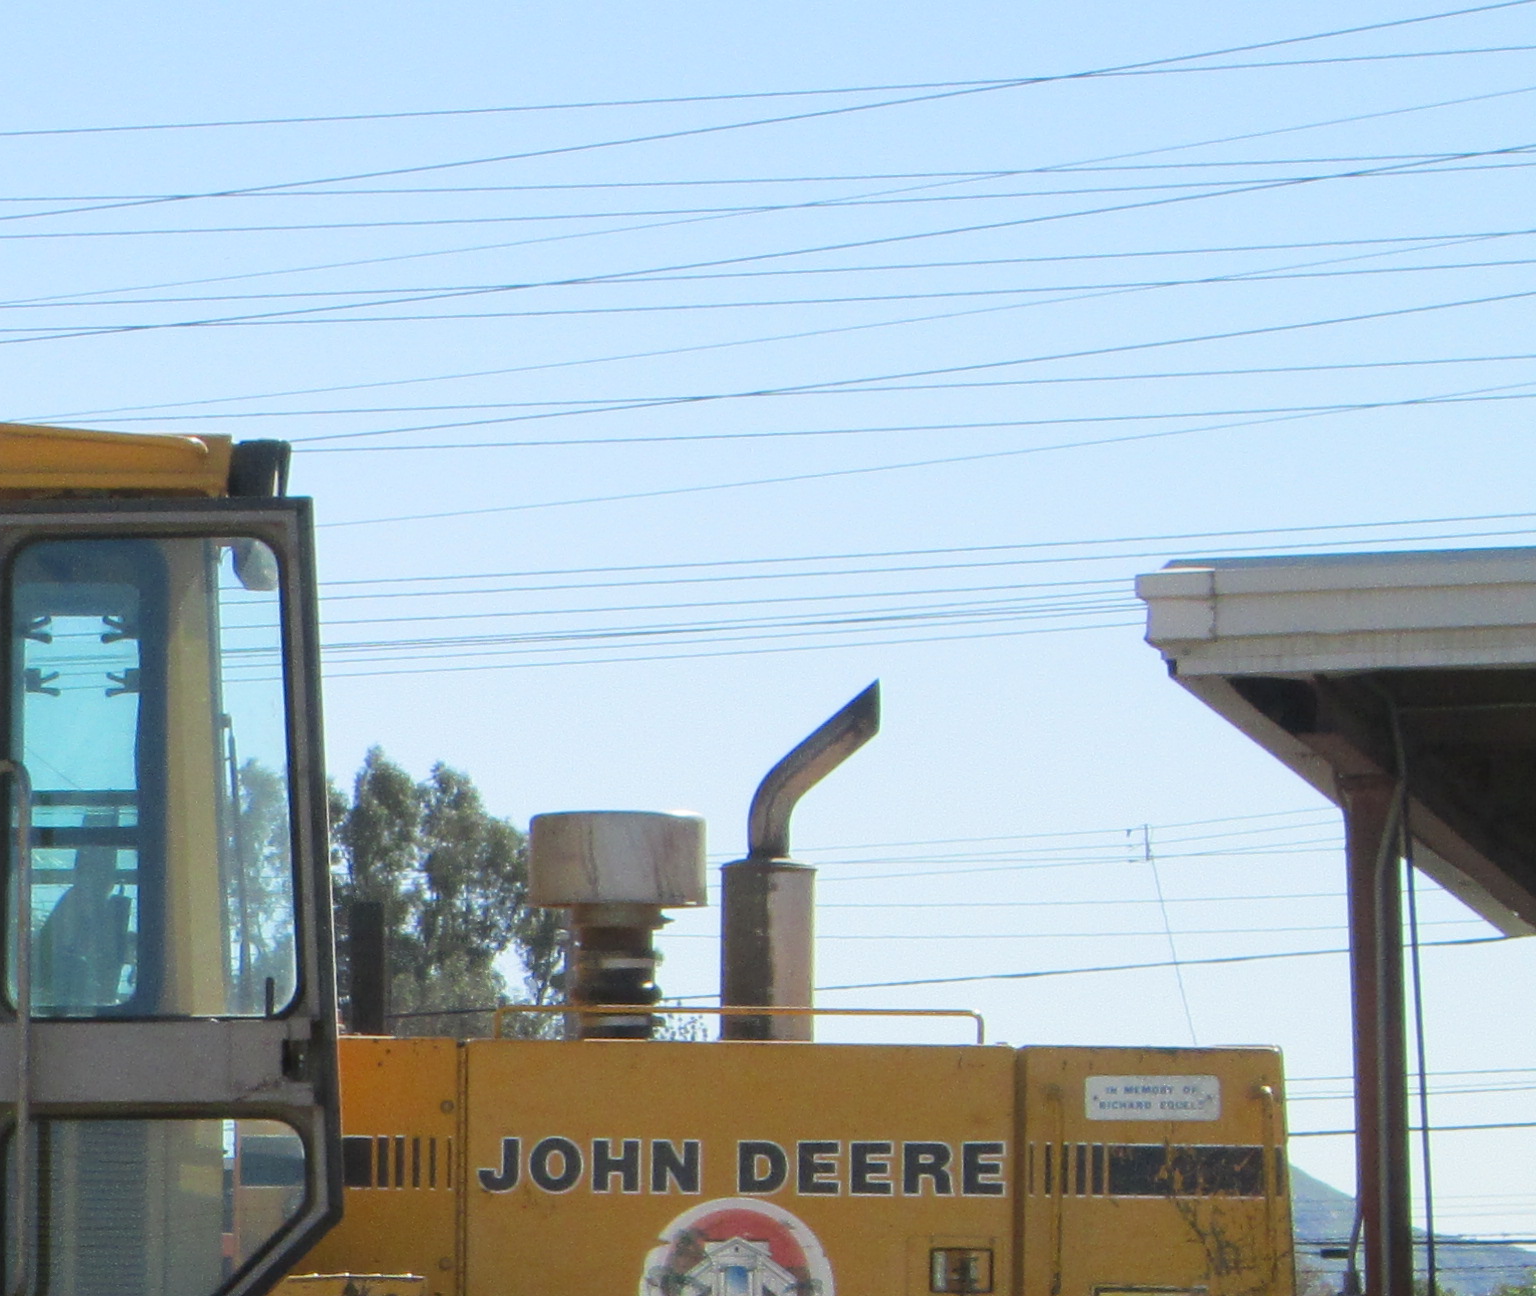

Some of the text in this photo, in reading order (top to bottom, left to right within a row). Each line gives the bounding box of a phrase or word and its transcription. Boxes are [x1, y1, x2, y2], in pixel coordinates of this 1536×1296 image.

[1123, 1085, 1174, 1095] MEMORY
[1182, 1086, 1199, 1095] OF
[1099, 1100, 1152, 1110] RICHARD
[477, 1136, 1007, 1198] JOHN DEERE
